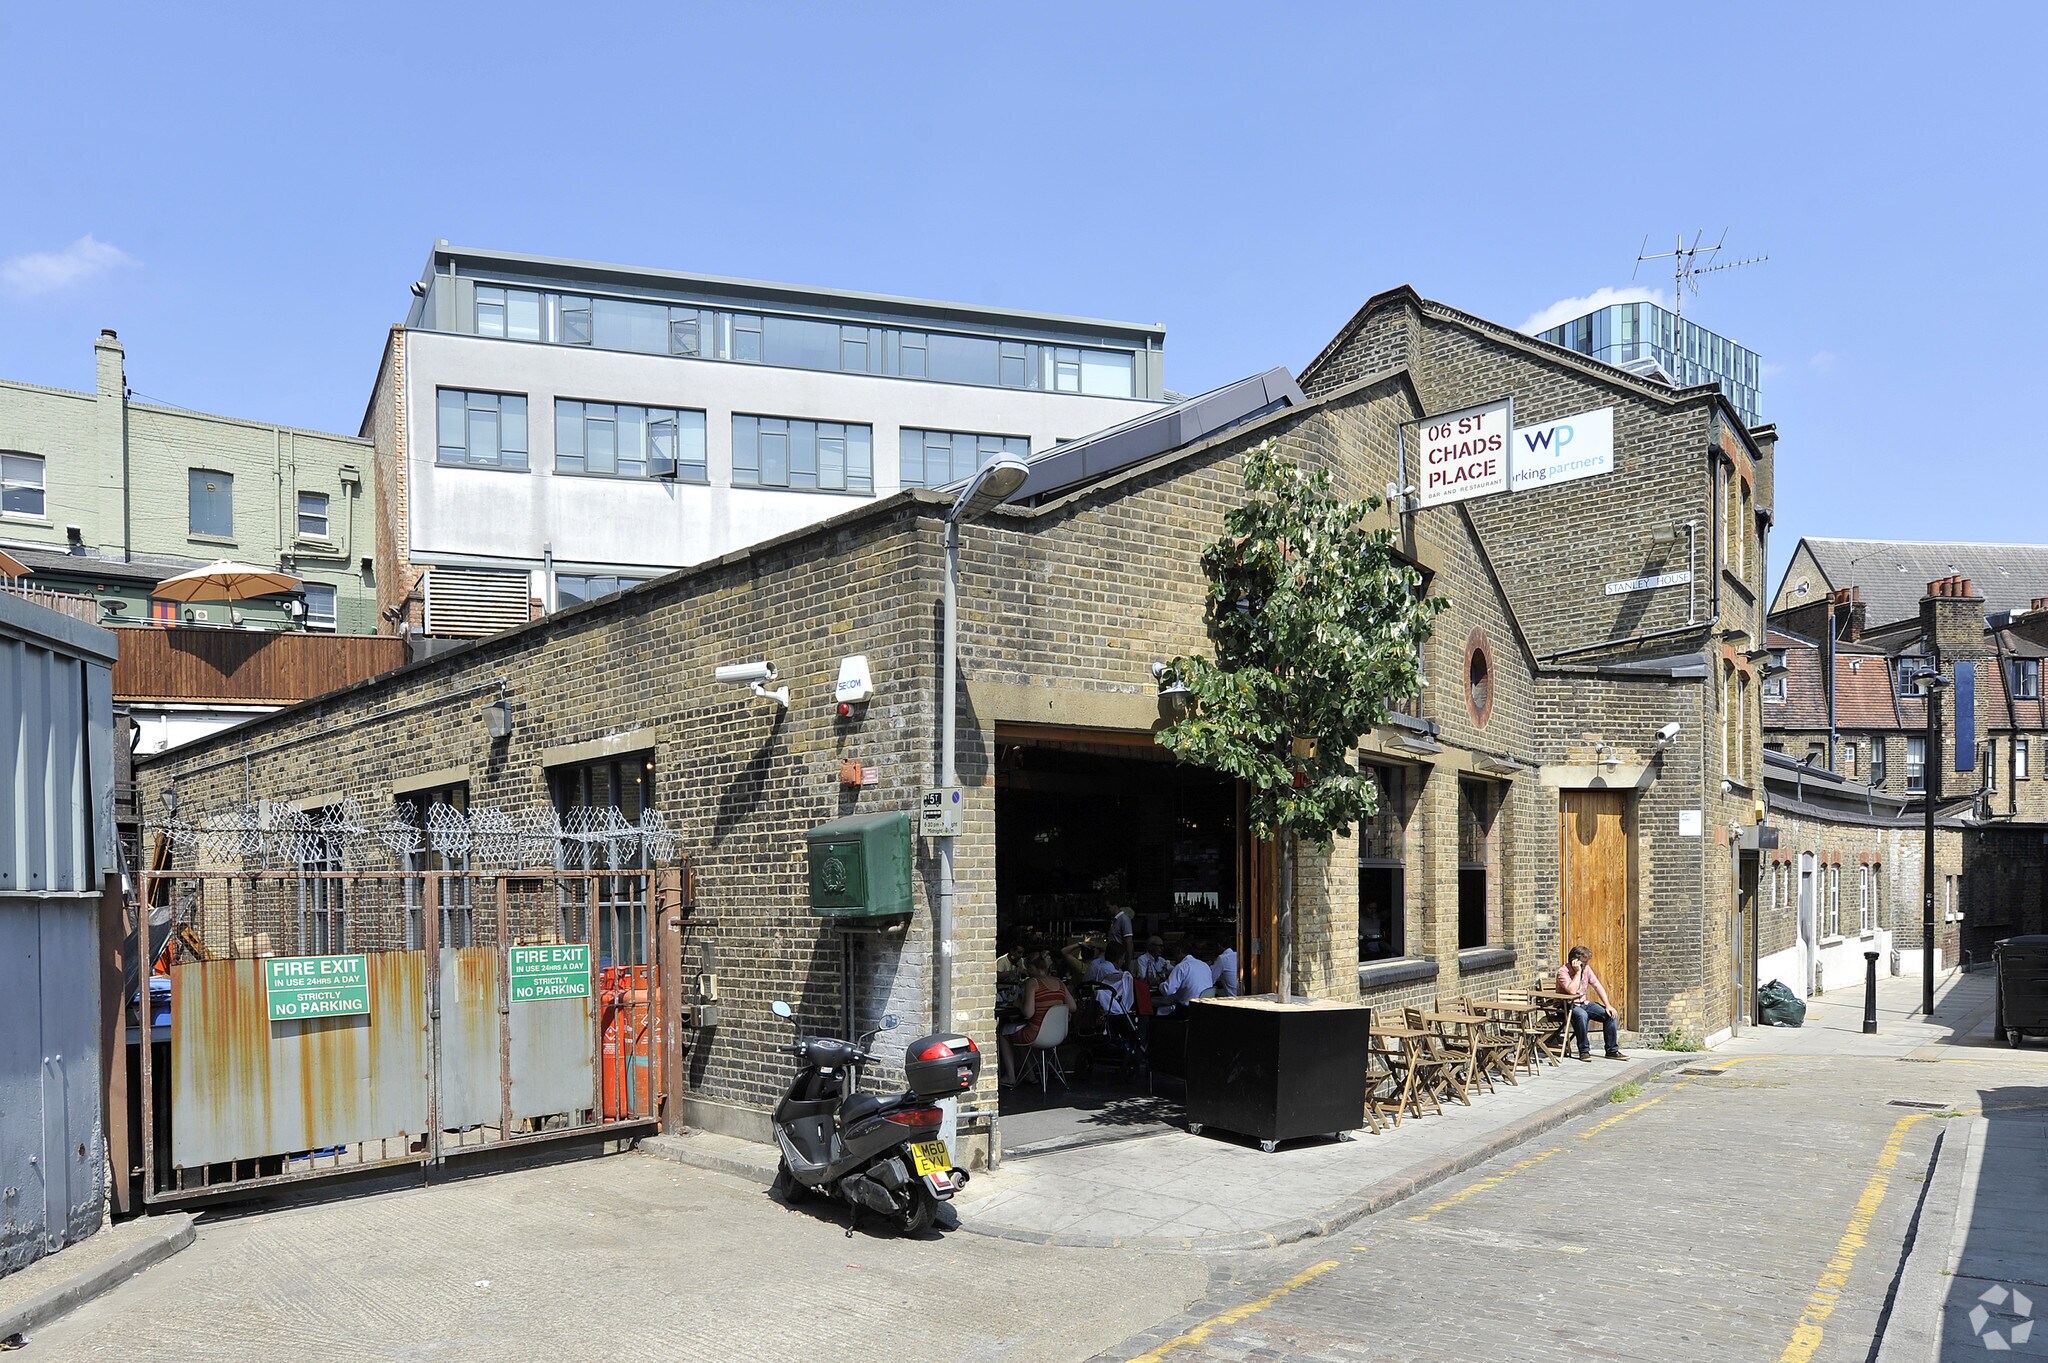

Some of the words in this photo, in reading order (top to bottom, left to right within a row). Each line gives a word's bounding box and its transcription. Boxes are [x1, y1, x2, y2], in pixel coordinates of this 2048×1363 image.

[1428, 422, 1451, 442] 06
[1458, 413, 1486, 435] ST
[1428, 434, 1502, 465] CHADS
[1429, 459, 1496, 489] PLACE
[1549, 455, 1604, 478] partners
[1428, 491, 1441, 499] BAR
[1443, 488, 1457, 496] AND
[1460, 479, 1503, 492] RESTAURANT
[1607, 577, 1650, 594] STANLEY
[1656, 572, 1689, 586] HOUSE
[838, 679, 861, 691] SECOM
[515, 950, 548, 964] FIRE
[553, 948, 584, 962] EXIT
[273, 961, 315, 977] FIRE
[320, 959, 359, 975] EXIT
[569, 962, 584, 970] DAY
[274, 979, 284, 987] IN
[286, 978, 305, 987] USE
[333, 976, 340, 984] A
[341, 975, 360, 983] DAY
[533, 976, 568, 986] STRICTLY
[296, 991, 341, 1002] STRICTLY
[516, 987, 534, 998] NO
[536, 984, 585, 996] PARKING
[275, 1003, 297, 1016] NO
[301, 999, 363, 1014] PARKING
[913, 1141, 945, 1159] LM60
[921, 1155, 944, 1171] EYV
